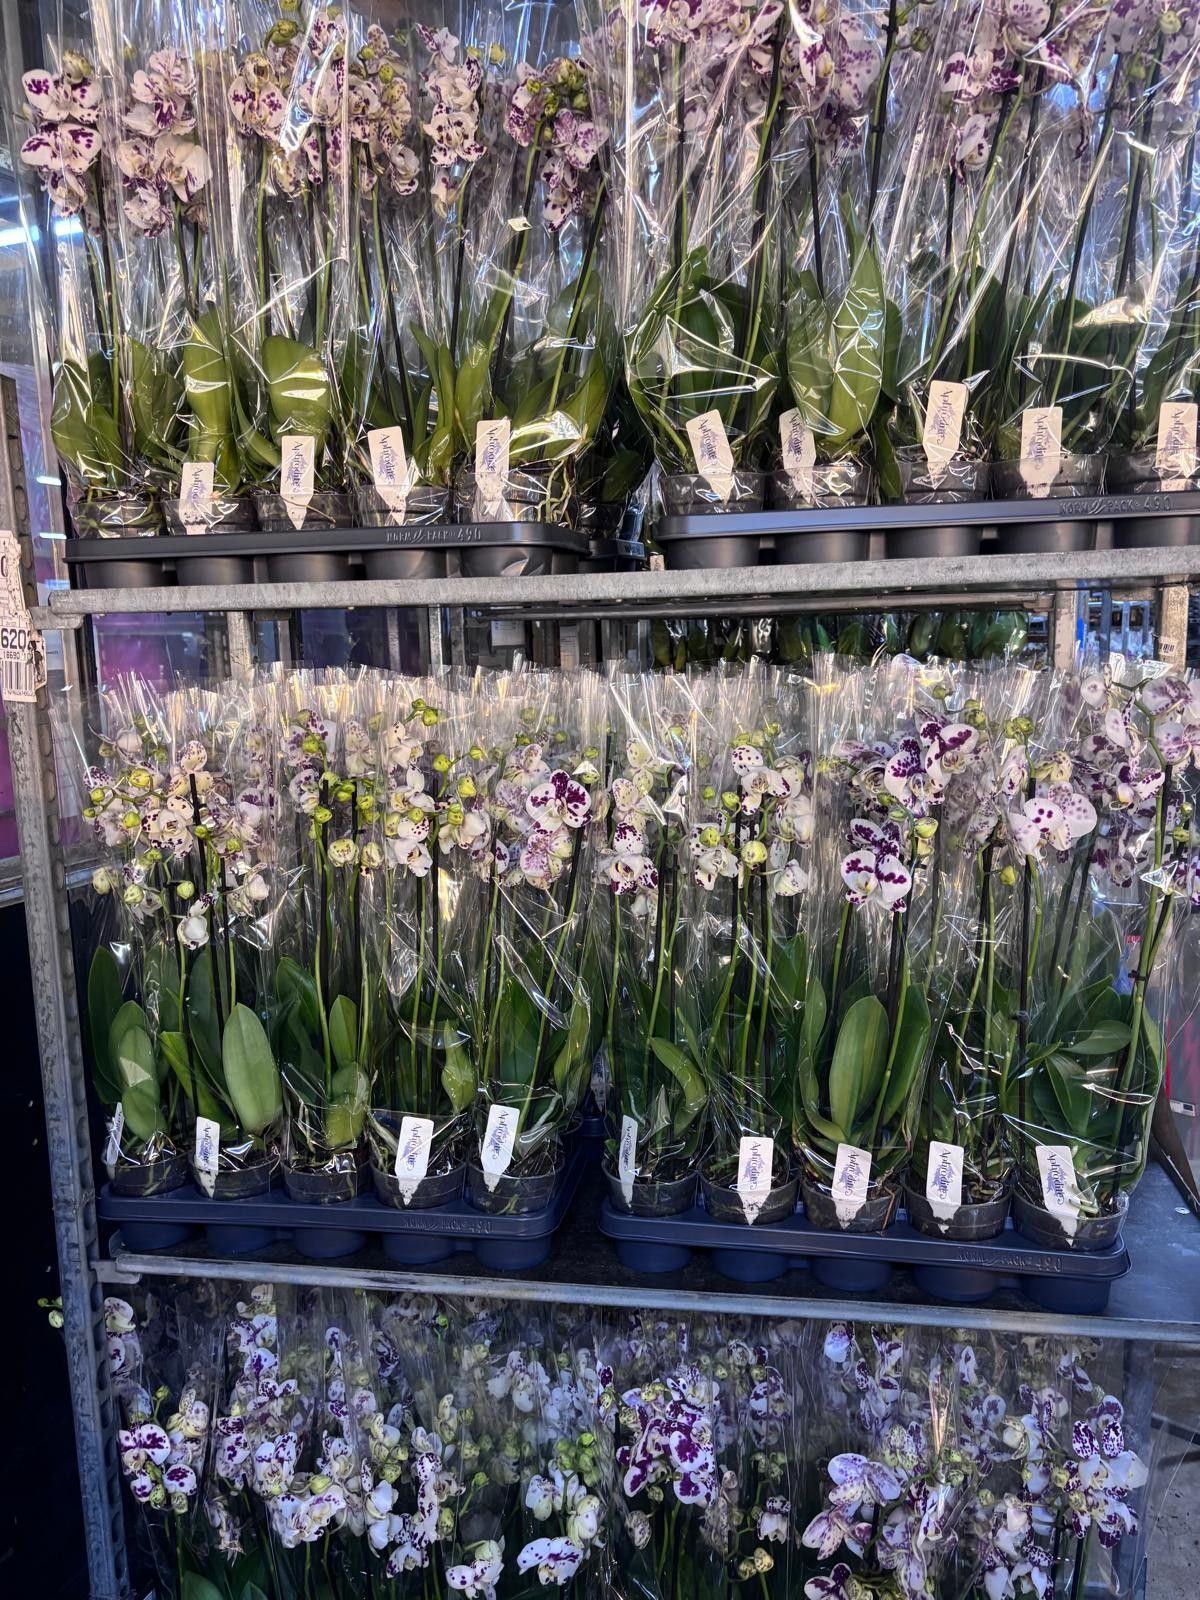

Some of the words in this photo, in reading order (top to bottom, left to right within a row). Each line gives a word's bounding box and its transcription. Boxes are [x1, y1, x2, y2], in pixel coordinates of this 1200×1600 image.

[698, 418, 718, 465] Aphrodite
[786, 411, 804, 462] Aphrodite
[937, 390, 953, 444] Aphrodite
[290, 442, 304, 493] Aphrodite
[379, 433, 396, 484] Aphrodite
[1143, 494, 1172, 510] 490
[458, 527, 481, 541] 490
[492, 1110, 509, 1160] Aphrodite
[749, 1143, 761, 1190] Aphrodite
[844, 1152, 860, 1197] Aphrodite
[938, 1149, 951, 1200] Aphrodite
[1047, 1153, 1066, 1206] Aphrodite
